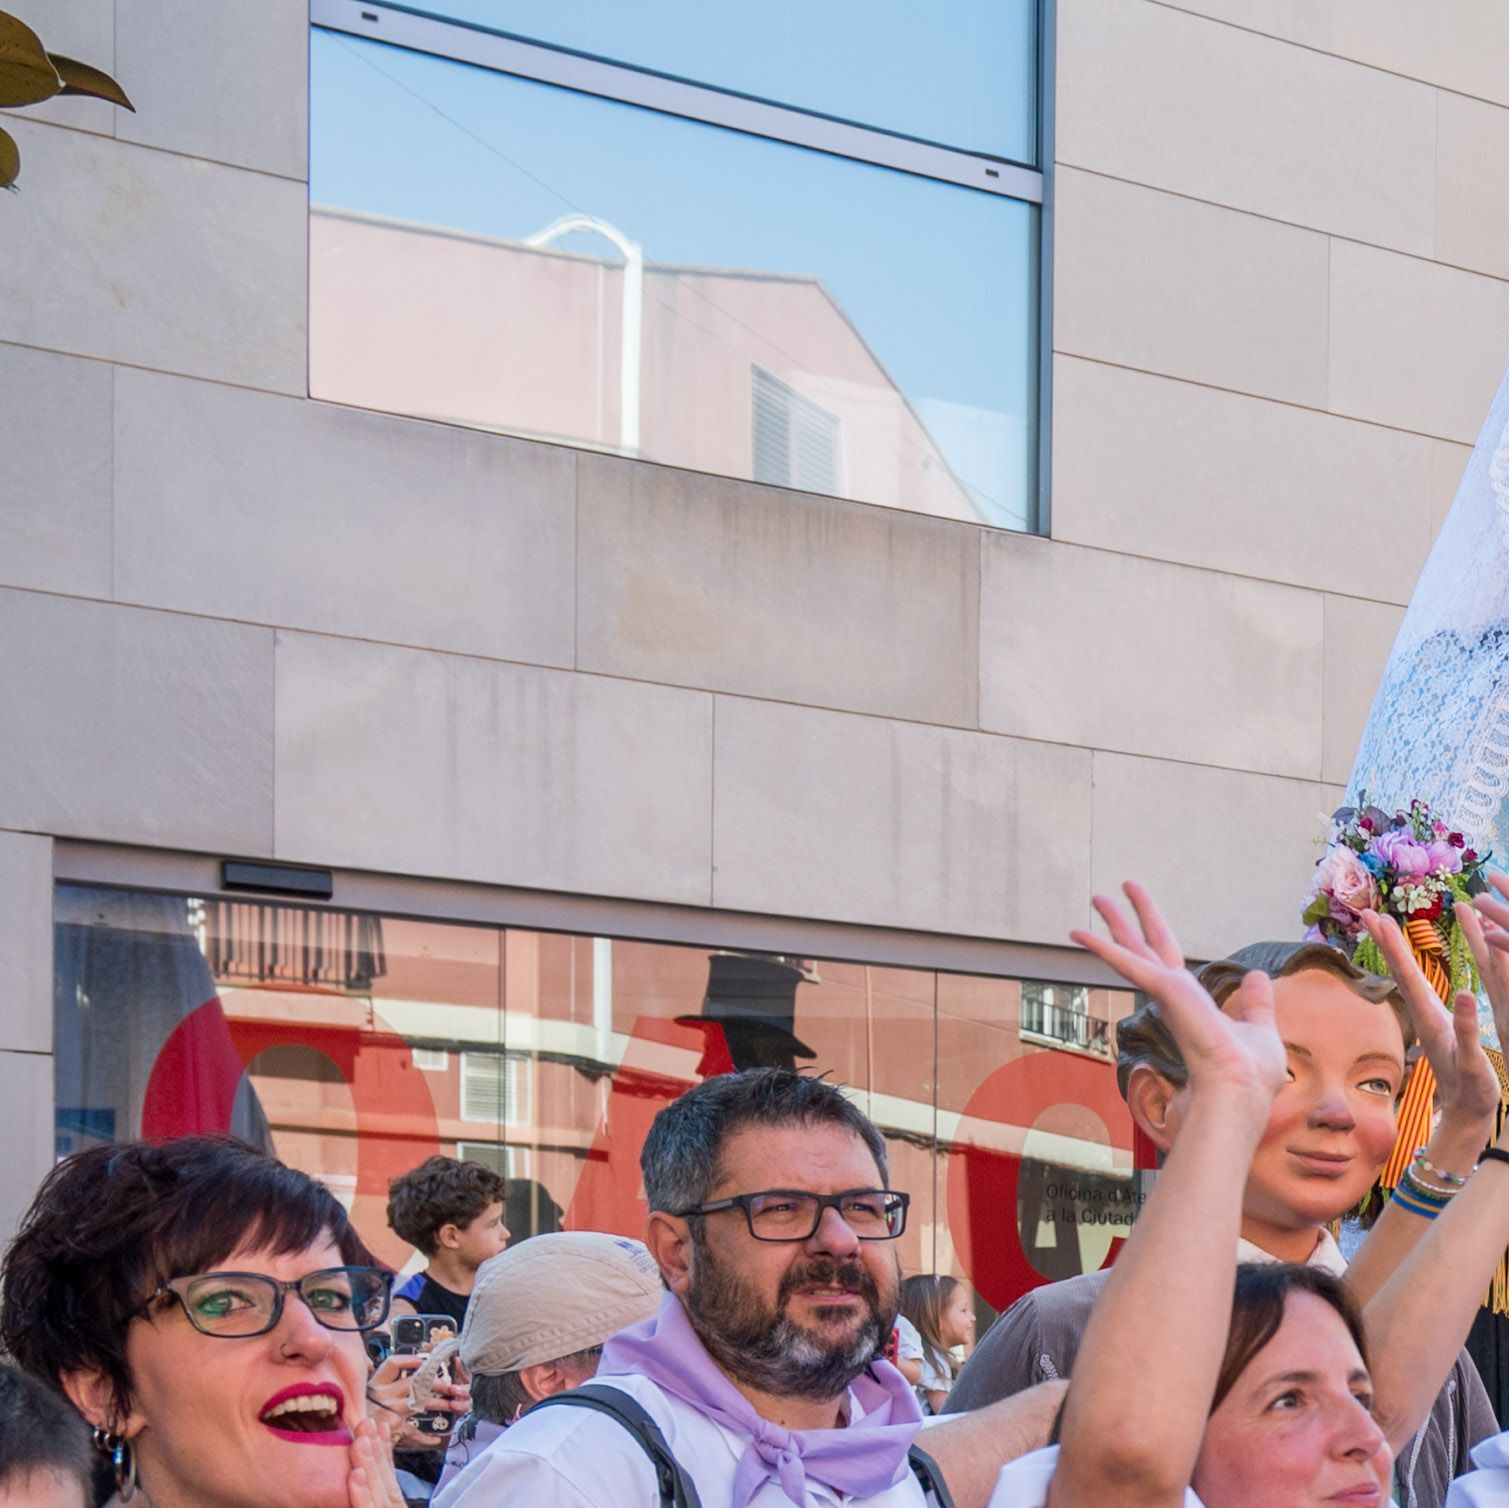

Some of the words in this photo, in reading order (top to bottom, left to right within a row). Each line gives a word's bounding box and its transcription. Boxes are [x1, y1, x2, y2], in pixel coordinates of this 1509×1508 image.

[1046, 1182, 1102, 1201] Oficina
[1107, 1185, 1148, 1204] d'Ate
[1061, 1207, 1076, 1222] la
[1081, 1208, 1134, 1226] Ciutad
